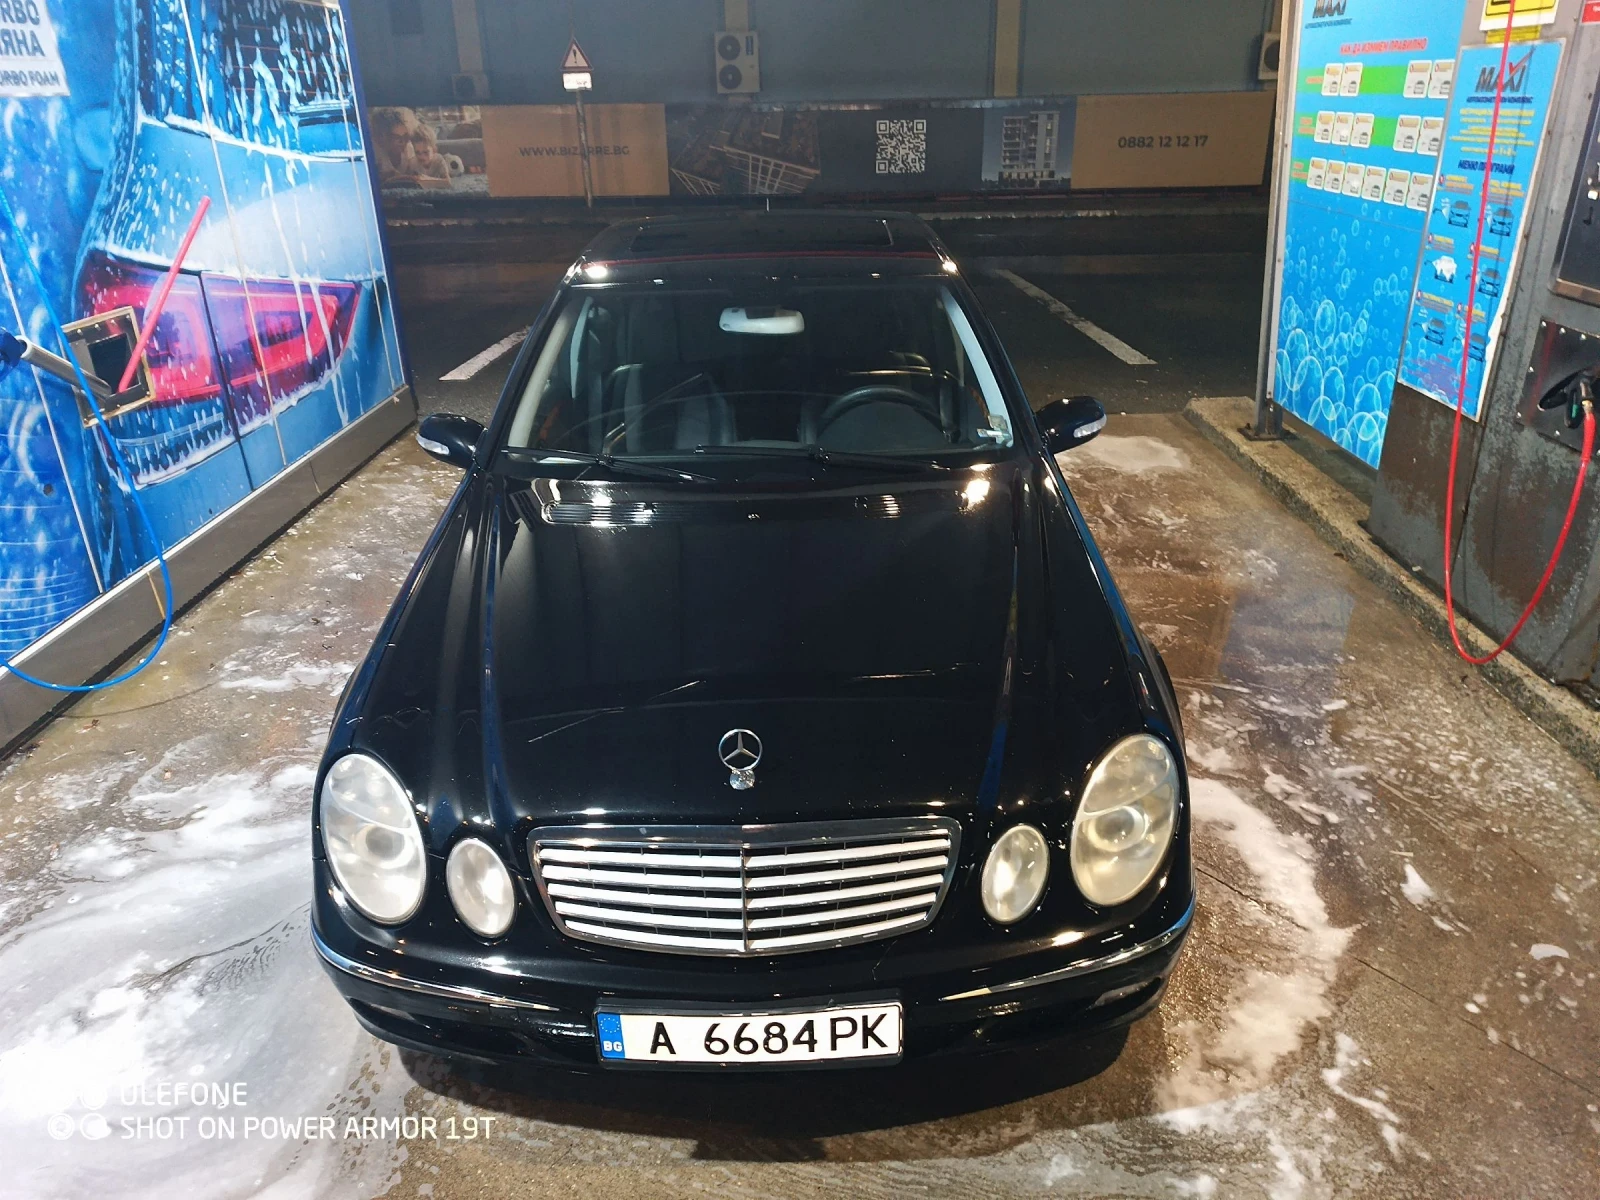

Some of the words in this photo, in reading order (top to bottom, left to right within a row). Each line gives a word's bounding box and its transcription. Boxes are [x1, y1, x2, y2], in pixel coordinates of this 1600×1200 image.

[1118, 135, 1155, 149] 0882
[1158, 135, 1173, 148] 12
[1176, 135, 1190, 148] 12
[1193, 134, 1209, 147] 17
[519, 145, 630, 157] WWW.BIZRRE.BG
[649, 1021, 677, 1055] A
[602, 1039, 623, 1052] BG
